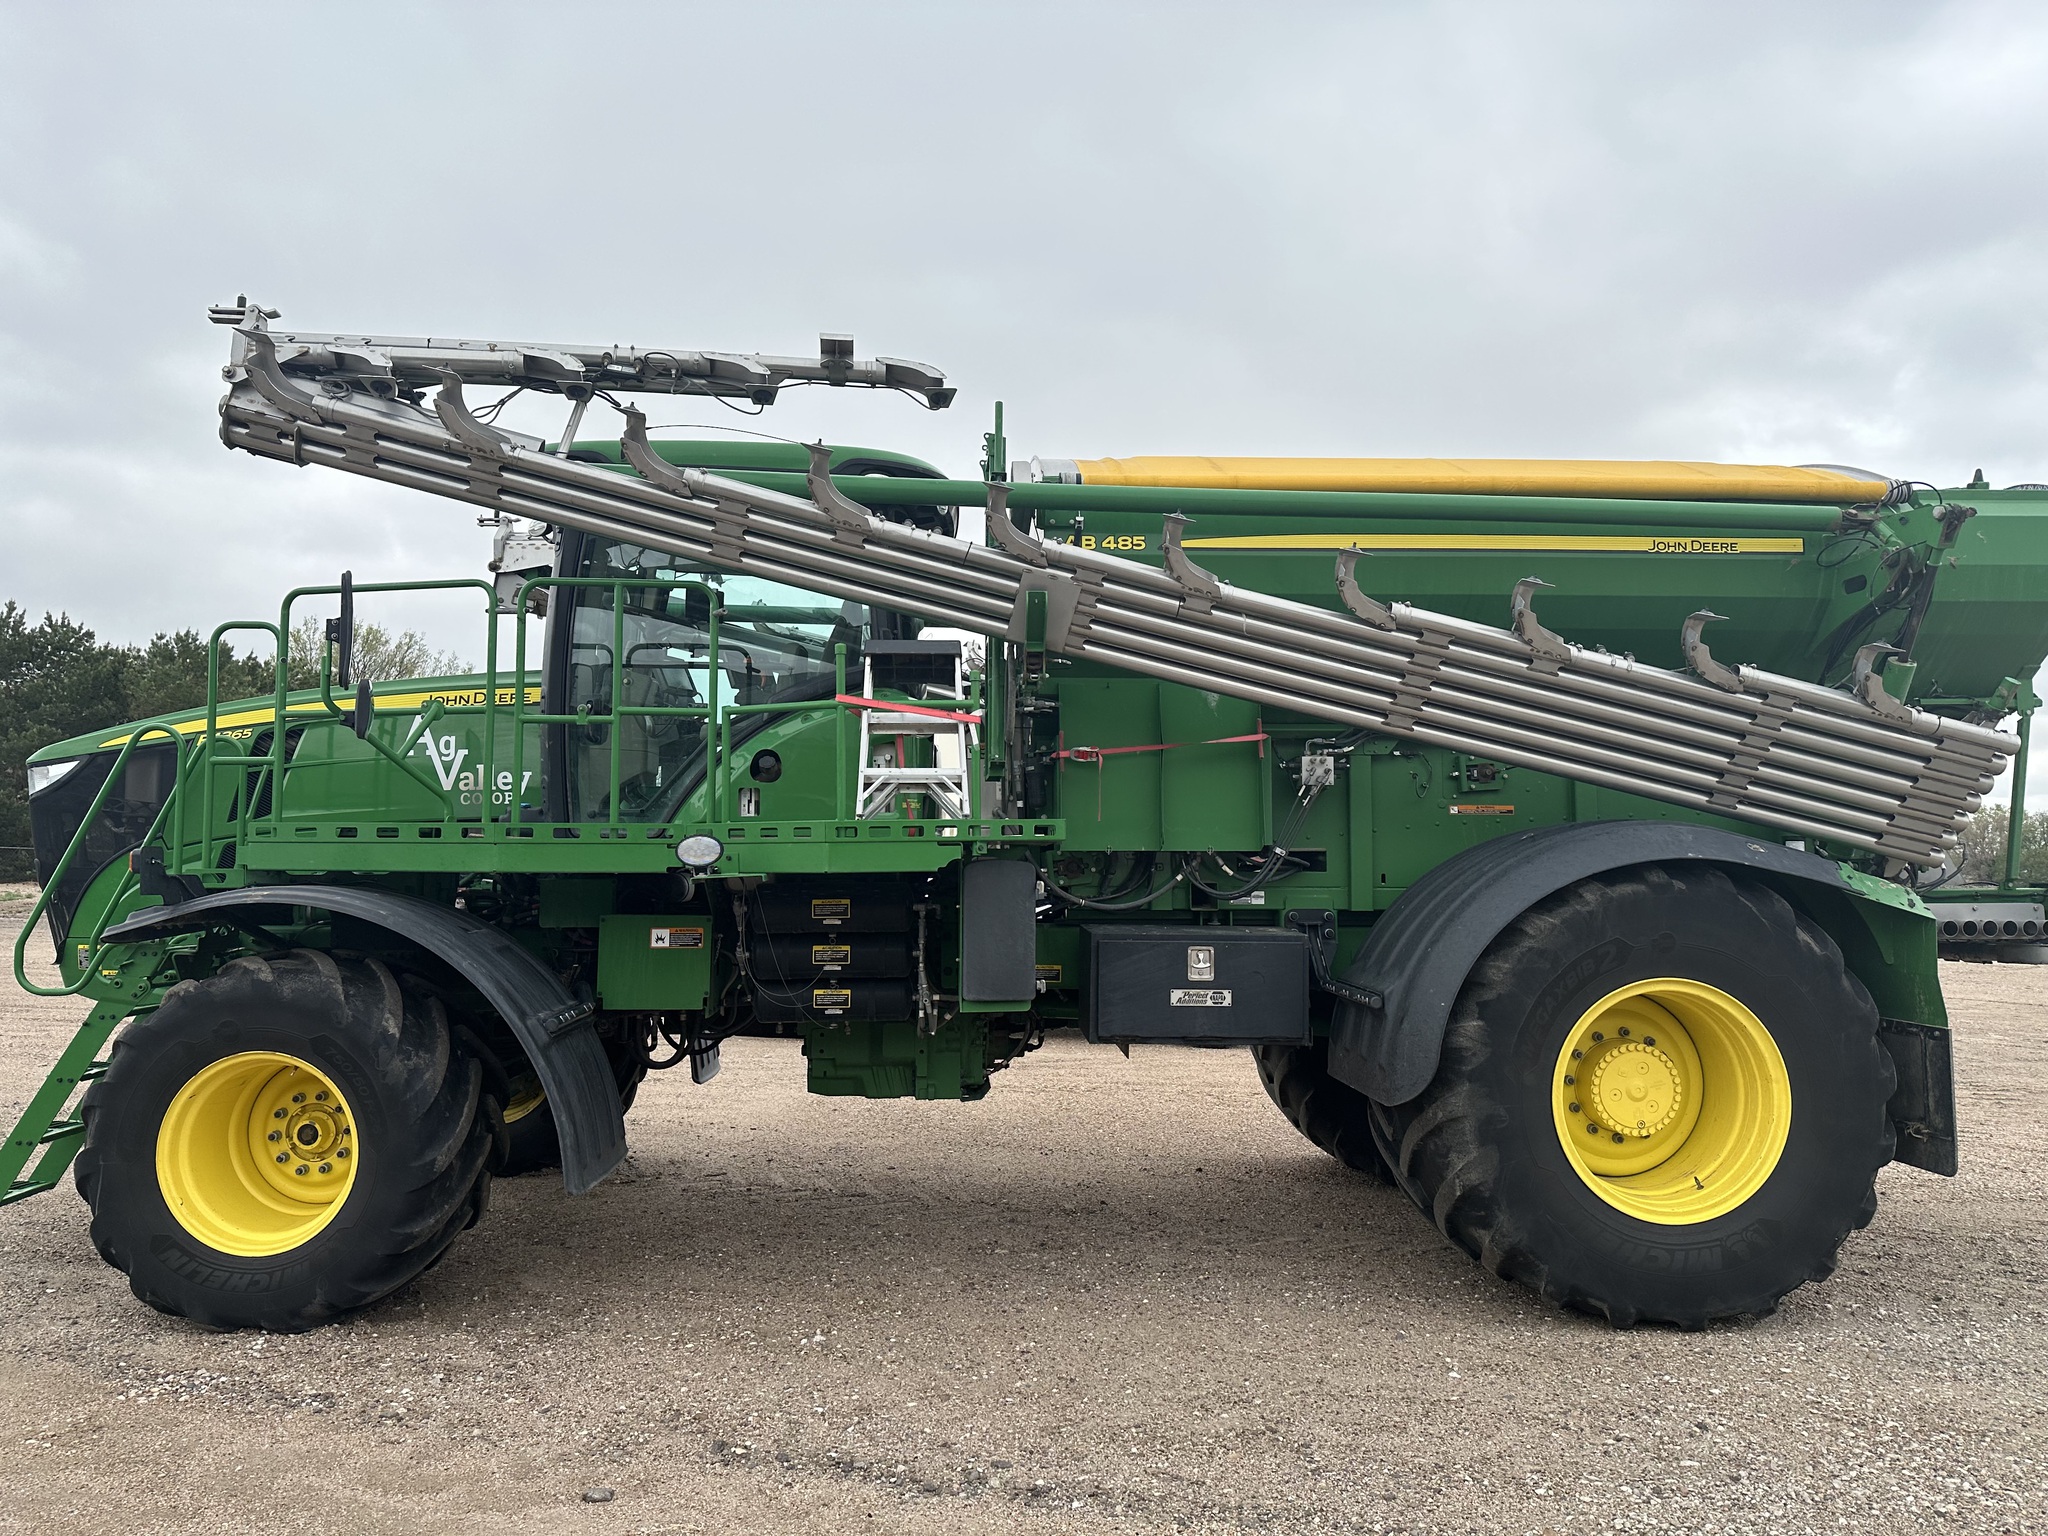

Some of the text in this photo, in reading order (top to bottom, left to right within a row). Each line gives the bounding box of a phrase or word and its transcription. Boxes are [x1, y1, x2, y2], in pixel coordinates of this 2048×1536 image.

[1101, 535, 1146, 550] 485
[1648, 540, 1738, 551] JOHN DEERE
[473, 692, 532, 704] DEE
[197, 728, 254, 746] F65
[403, 715, 457, 761] Ag
